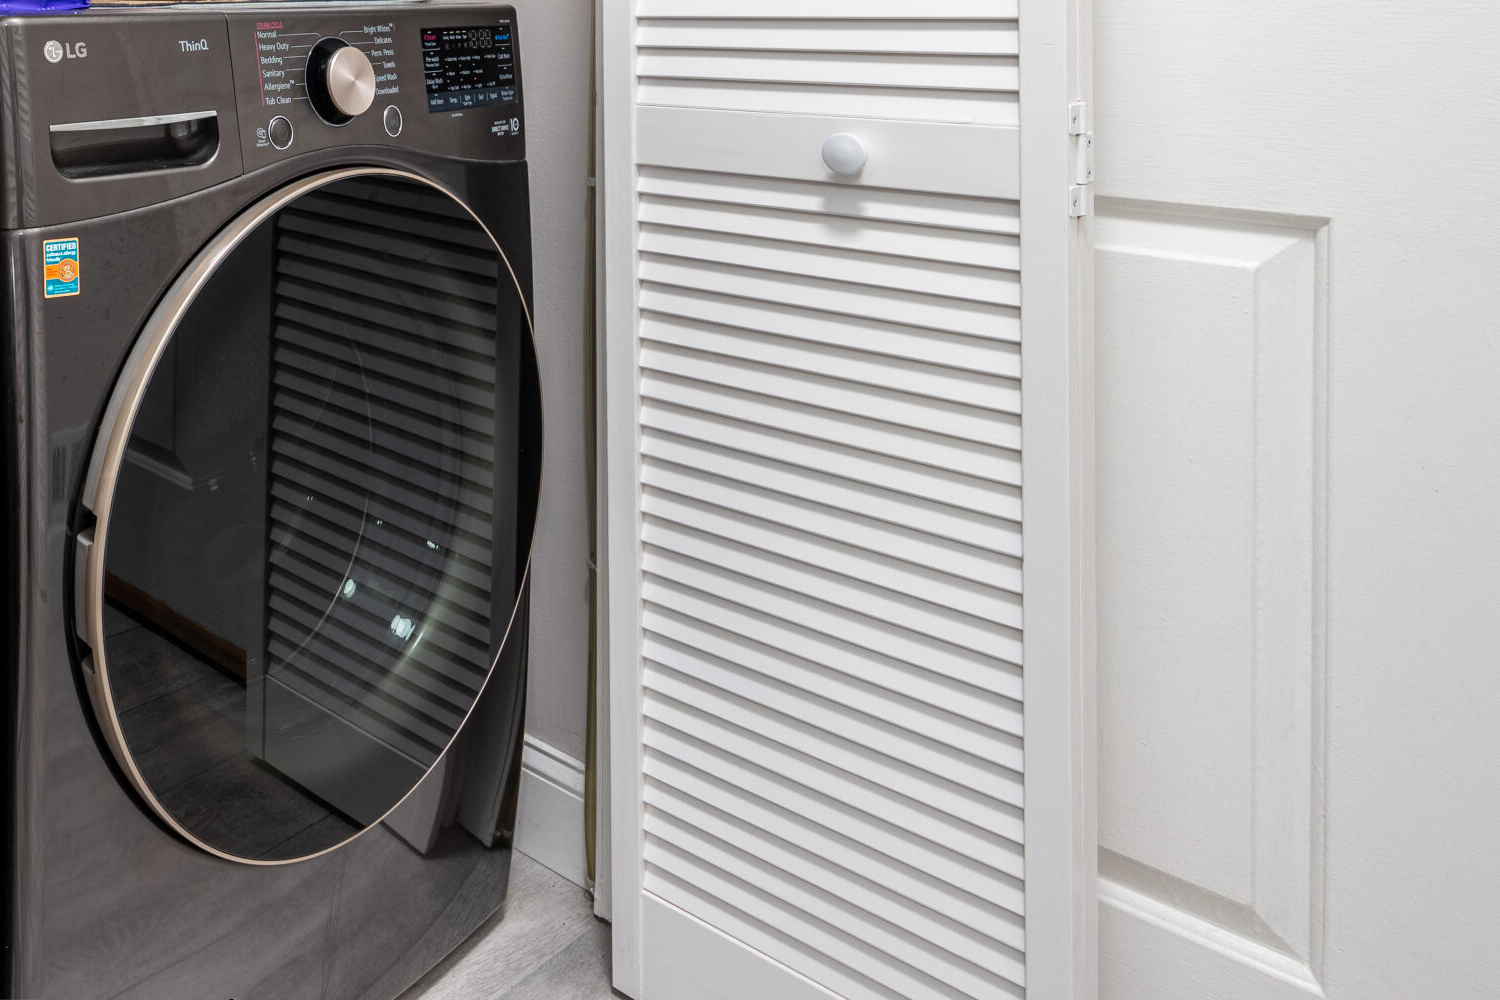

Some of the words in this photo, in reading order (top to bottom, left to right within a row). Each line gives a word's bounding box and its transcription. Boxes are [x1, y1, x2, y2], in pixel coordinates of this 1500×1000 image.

[257, 31, 277, 39] Normal
[364, 26, 376, 34] Bright
[374, 36, 392, 44] Delicates
[66, 42, 88, 60] LG
[178, 38, 210, 54] ThinQ
[258, 44, 276, 52] Heavy
[276, 42, 290, 52] Duty
[260, 56, 283, 66] Bedding
[262, 70, 285, 78] Sanitary
[376, 86, 398, 96] Downloaded
[266, 97, 276, 106] Tub
[276, 96, 292, 104] Clean
[46, 242, 76, 252] CERTIFIED
